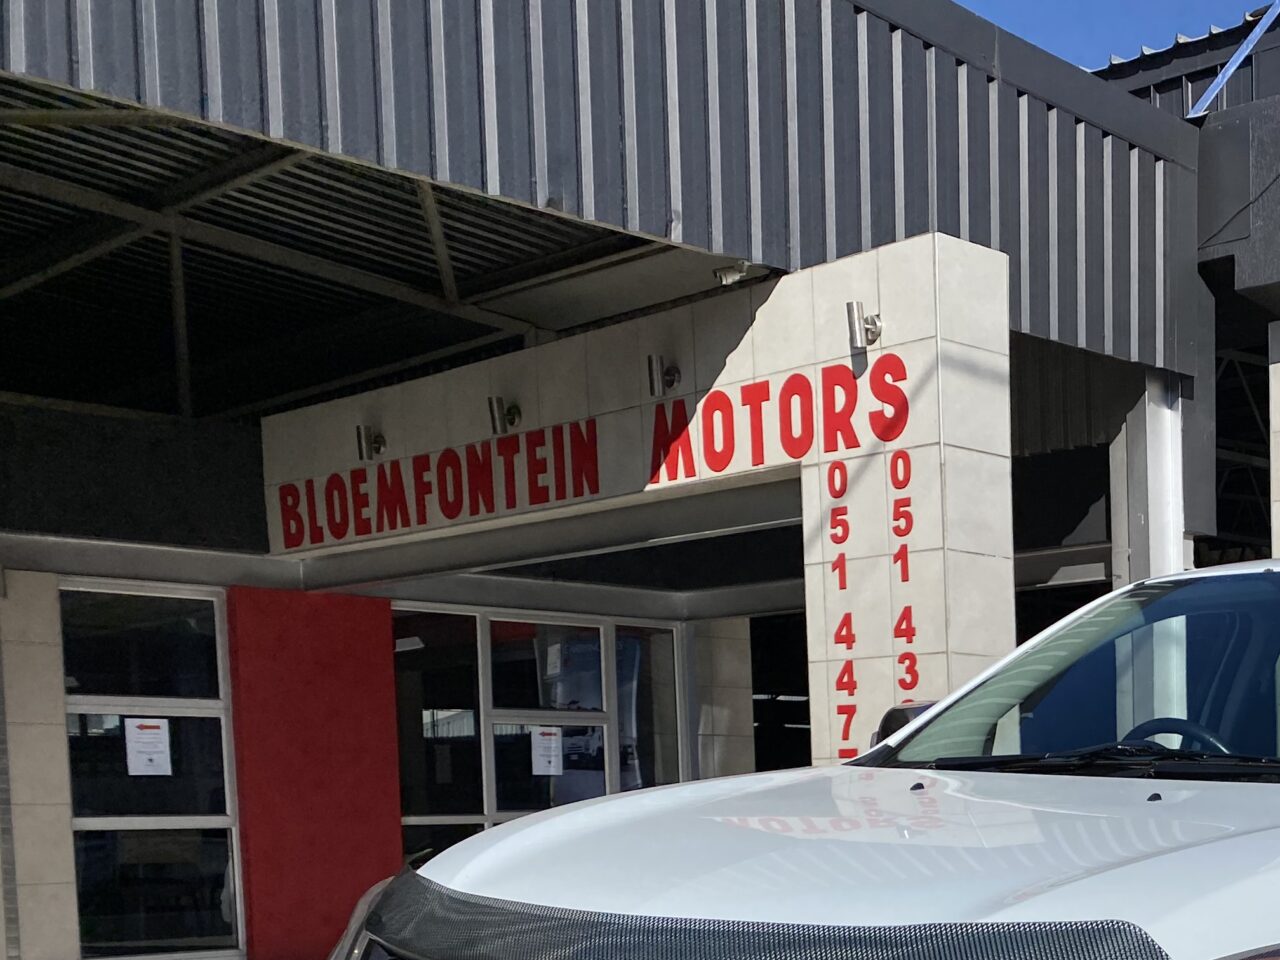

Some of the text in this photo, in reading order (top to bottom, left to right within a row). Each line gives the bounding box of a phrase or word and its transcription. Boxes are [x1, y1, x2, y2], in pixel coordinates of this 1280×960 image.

[278, 352, 910, 549] BLOEMFONTEIN MOTORS
[894, 605, 919, 704] 43
